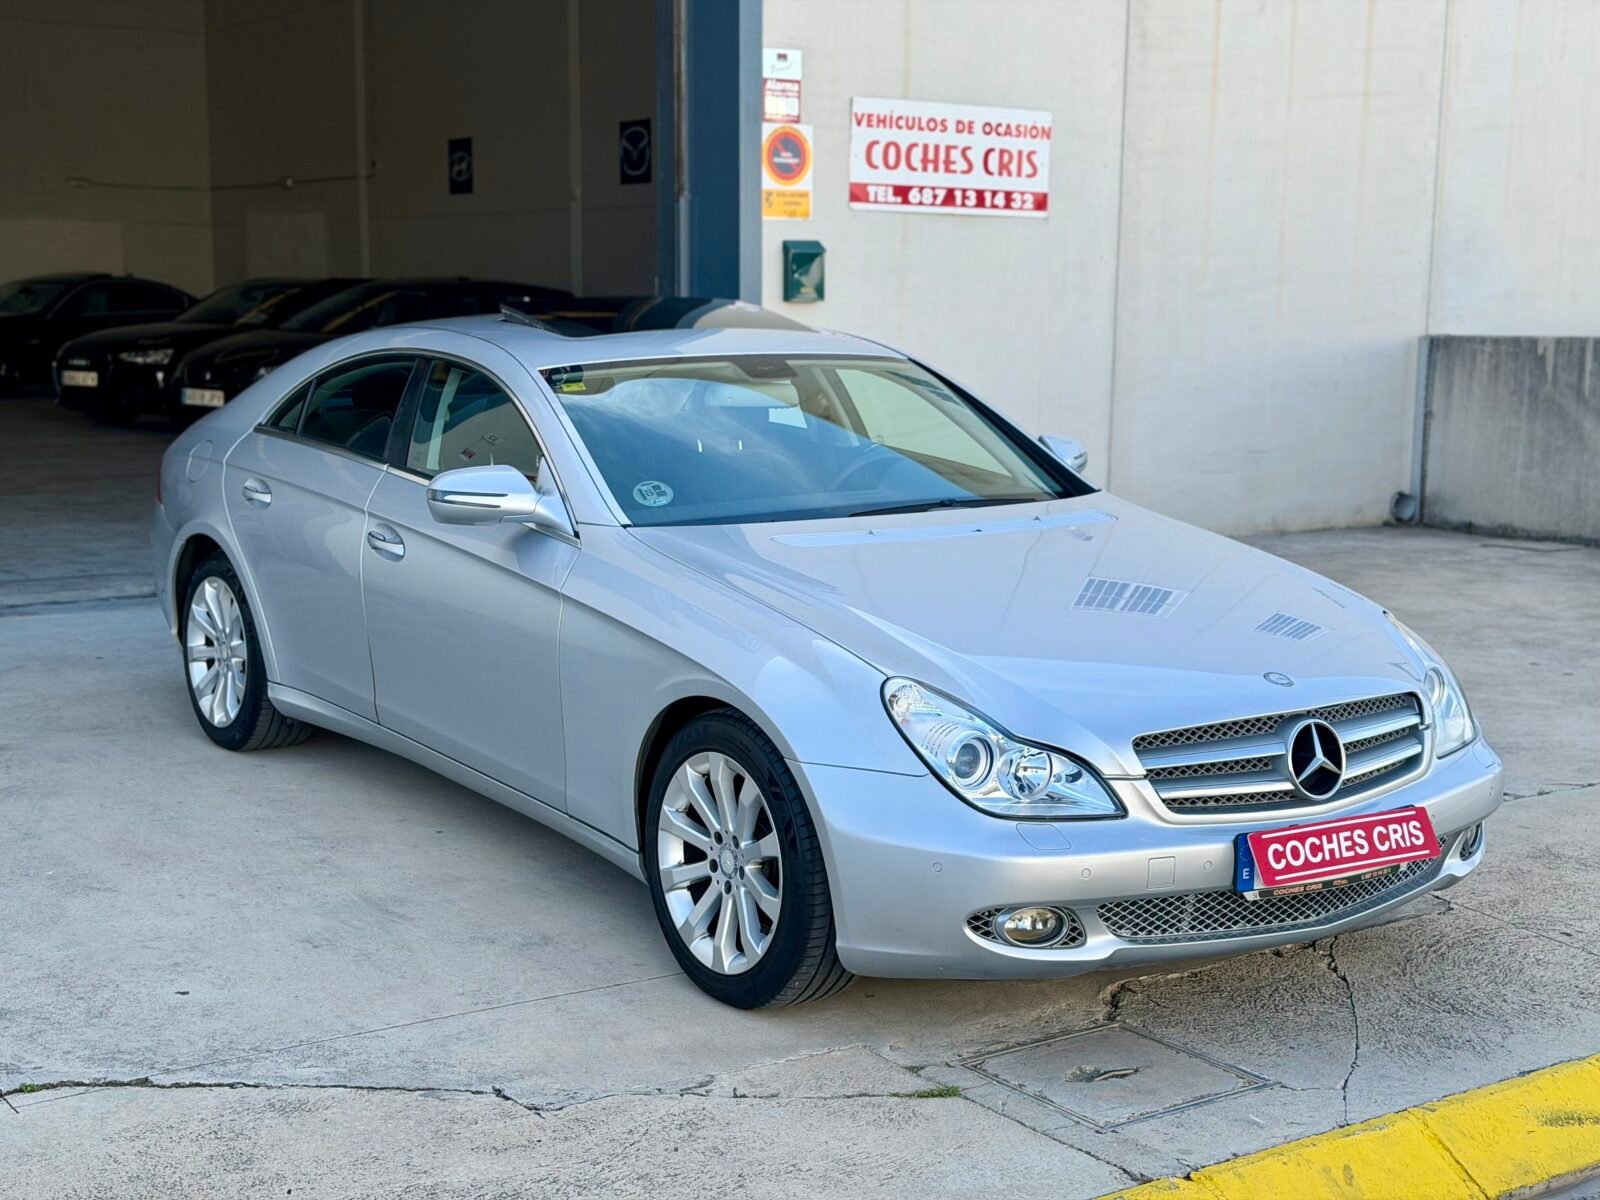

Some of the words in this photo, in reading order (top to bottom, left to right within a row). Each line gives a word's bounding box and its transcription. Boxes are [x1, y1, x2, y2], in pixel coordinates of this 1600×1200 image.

[854, 110, 948, 133] VEHÍCULOS
[955, 119, 975, 134] DE
[982, 121, 1052, 140] OCASIÓN
[865, 140, 974, 174] COCHES
[982, 148, 1038, 178] CRIS
[866, 185, 902, 203] TEL.
[908, 187, 947, 205] 687
[954, 189, 977, 206] 13
[984, 191, 1006, 208] 14
[1010, 192, 1034, 209] 32
[1267, 829, 1369, 870] COCHES
[1373, 820, 1425, 851] CRIS
[1242, 868, 1250, 879] E
[1273, 885, 1305, 896] COCHES
[1306, 883, 1323, 892] CRIS
